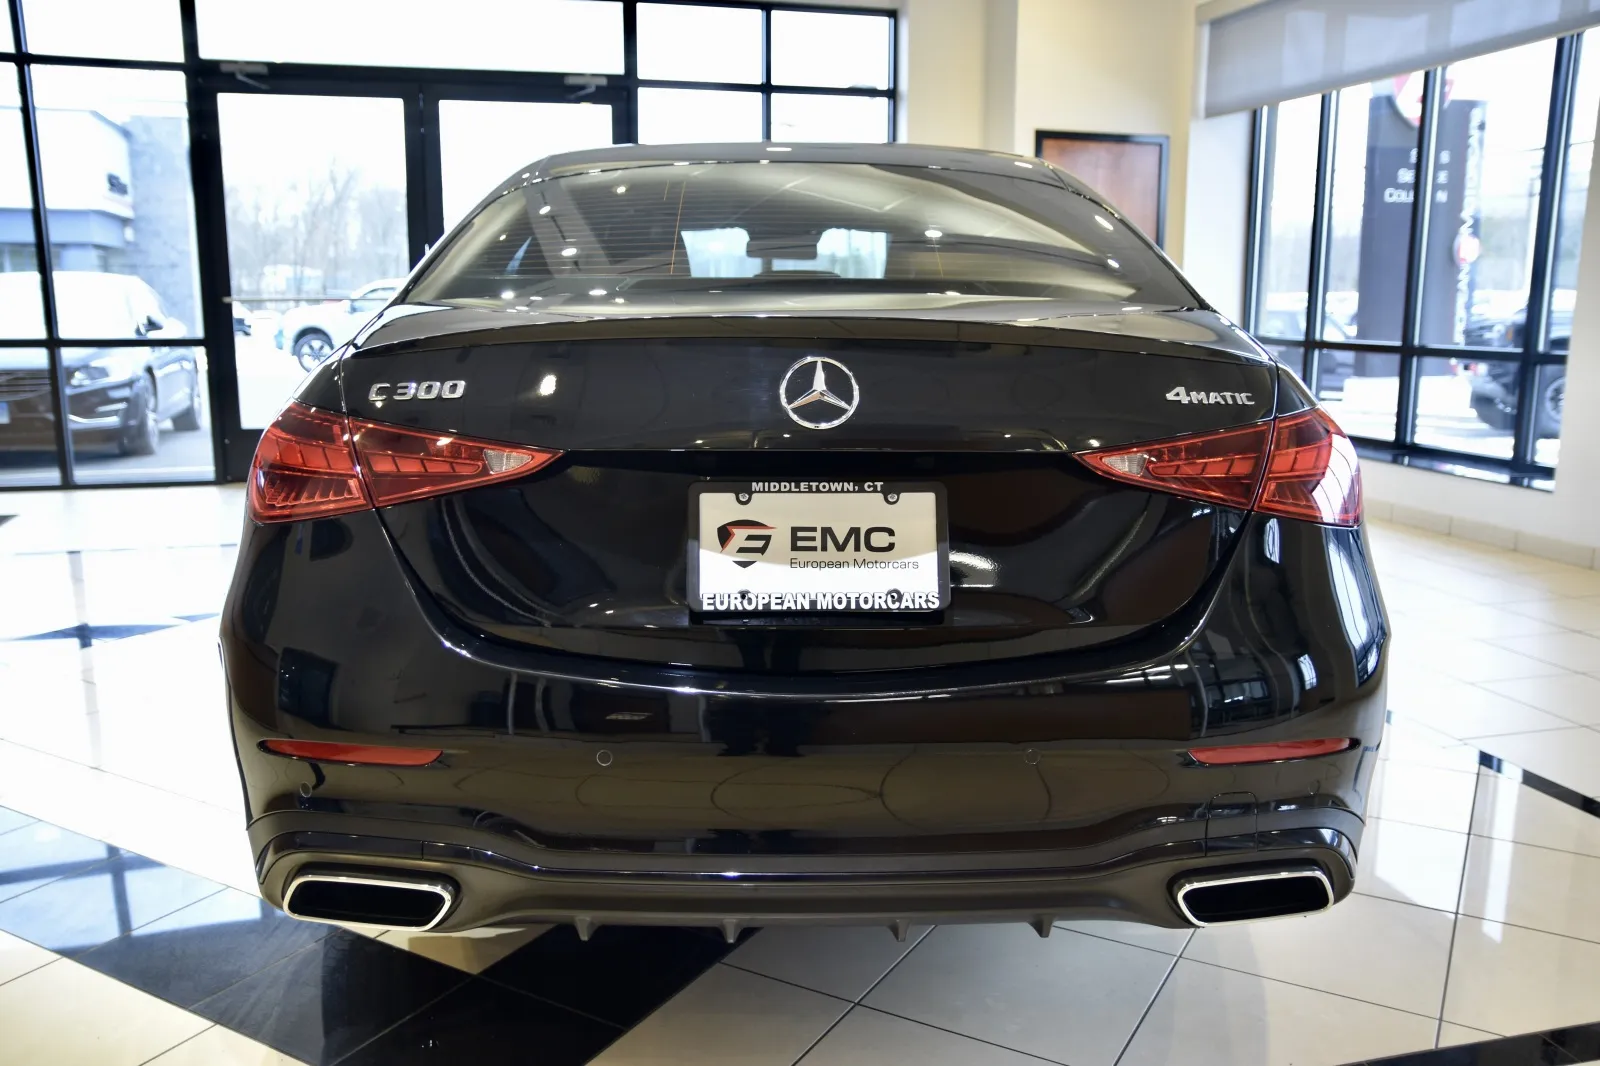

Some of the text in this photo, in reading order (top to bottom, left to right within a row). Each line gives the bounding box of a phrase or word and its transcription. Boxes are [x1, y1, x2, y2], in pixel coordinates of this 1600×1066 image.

[368, 380, 466, 401] C 300
[1165, 386, 1255, 405] 4MATIC
[751, 481, 884, 492] MIDDLETOWN, CT
[790, 526, 896, 553] EMC
[790, 557, 919, 571] European Motorcars
[702, 591, 940, 611] EUROPEAN MOTORCARS
